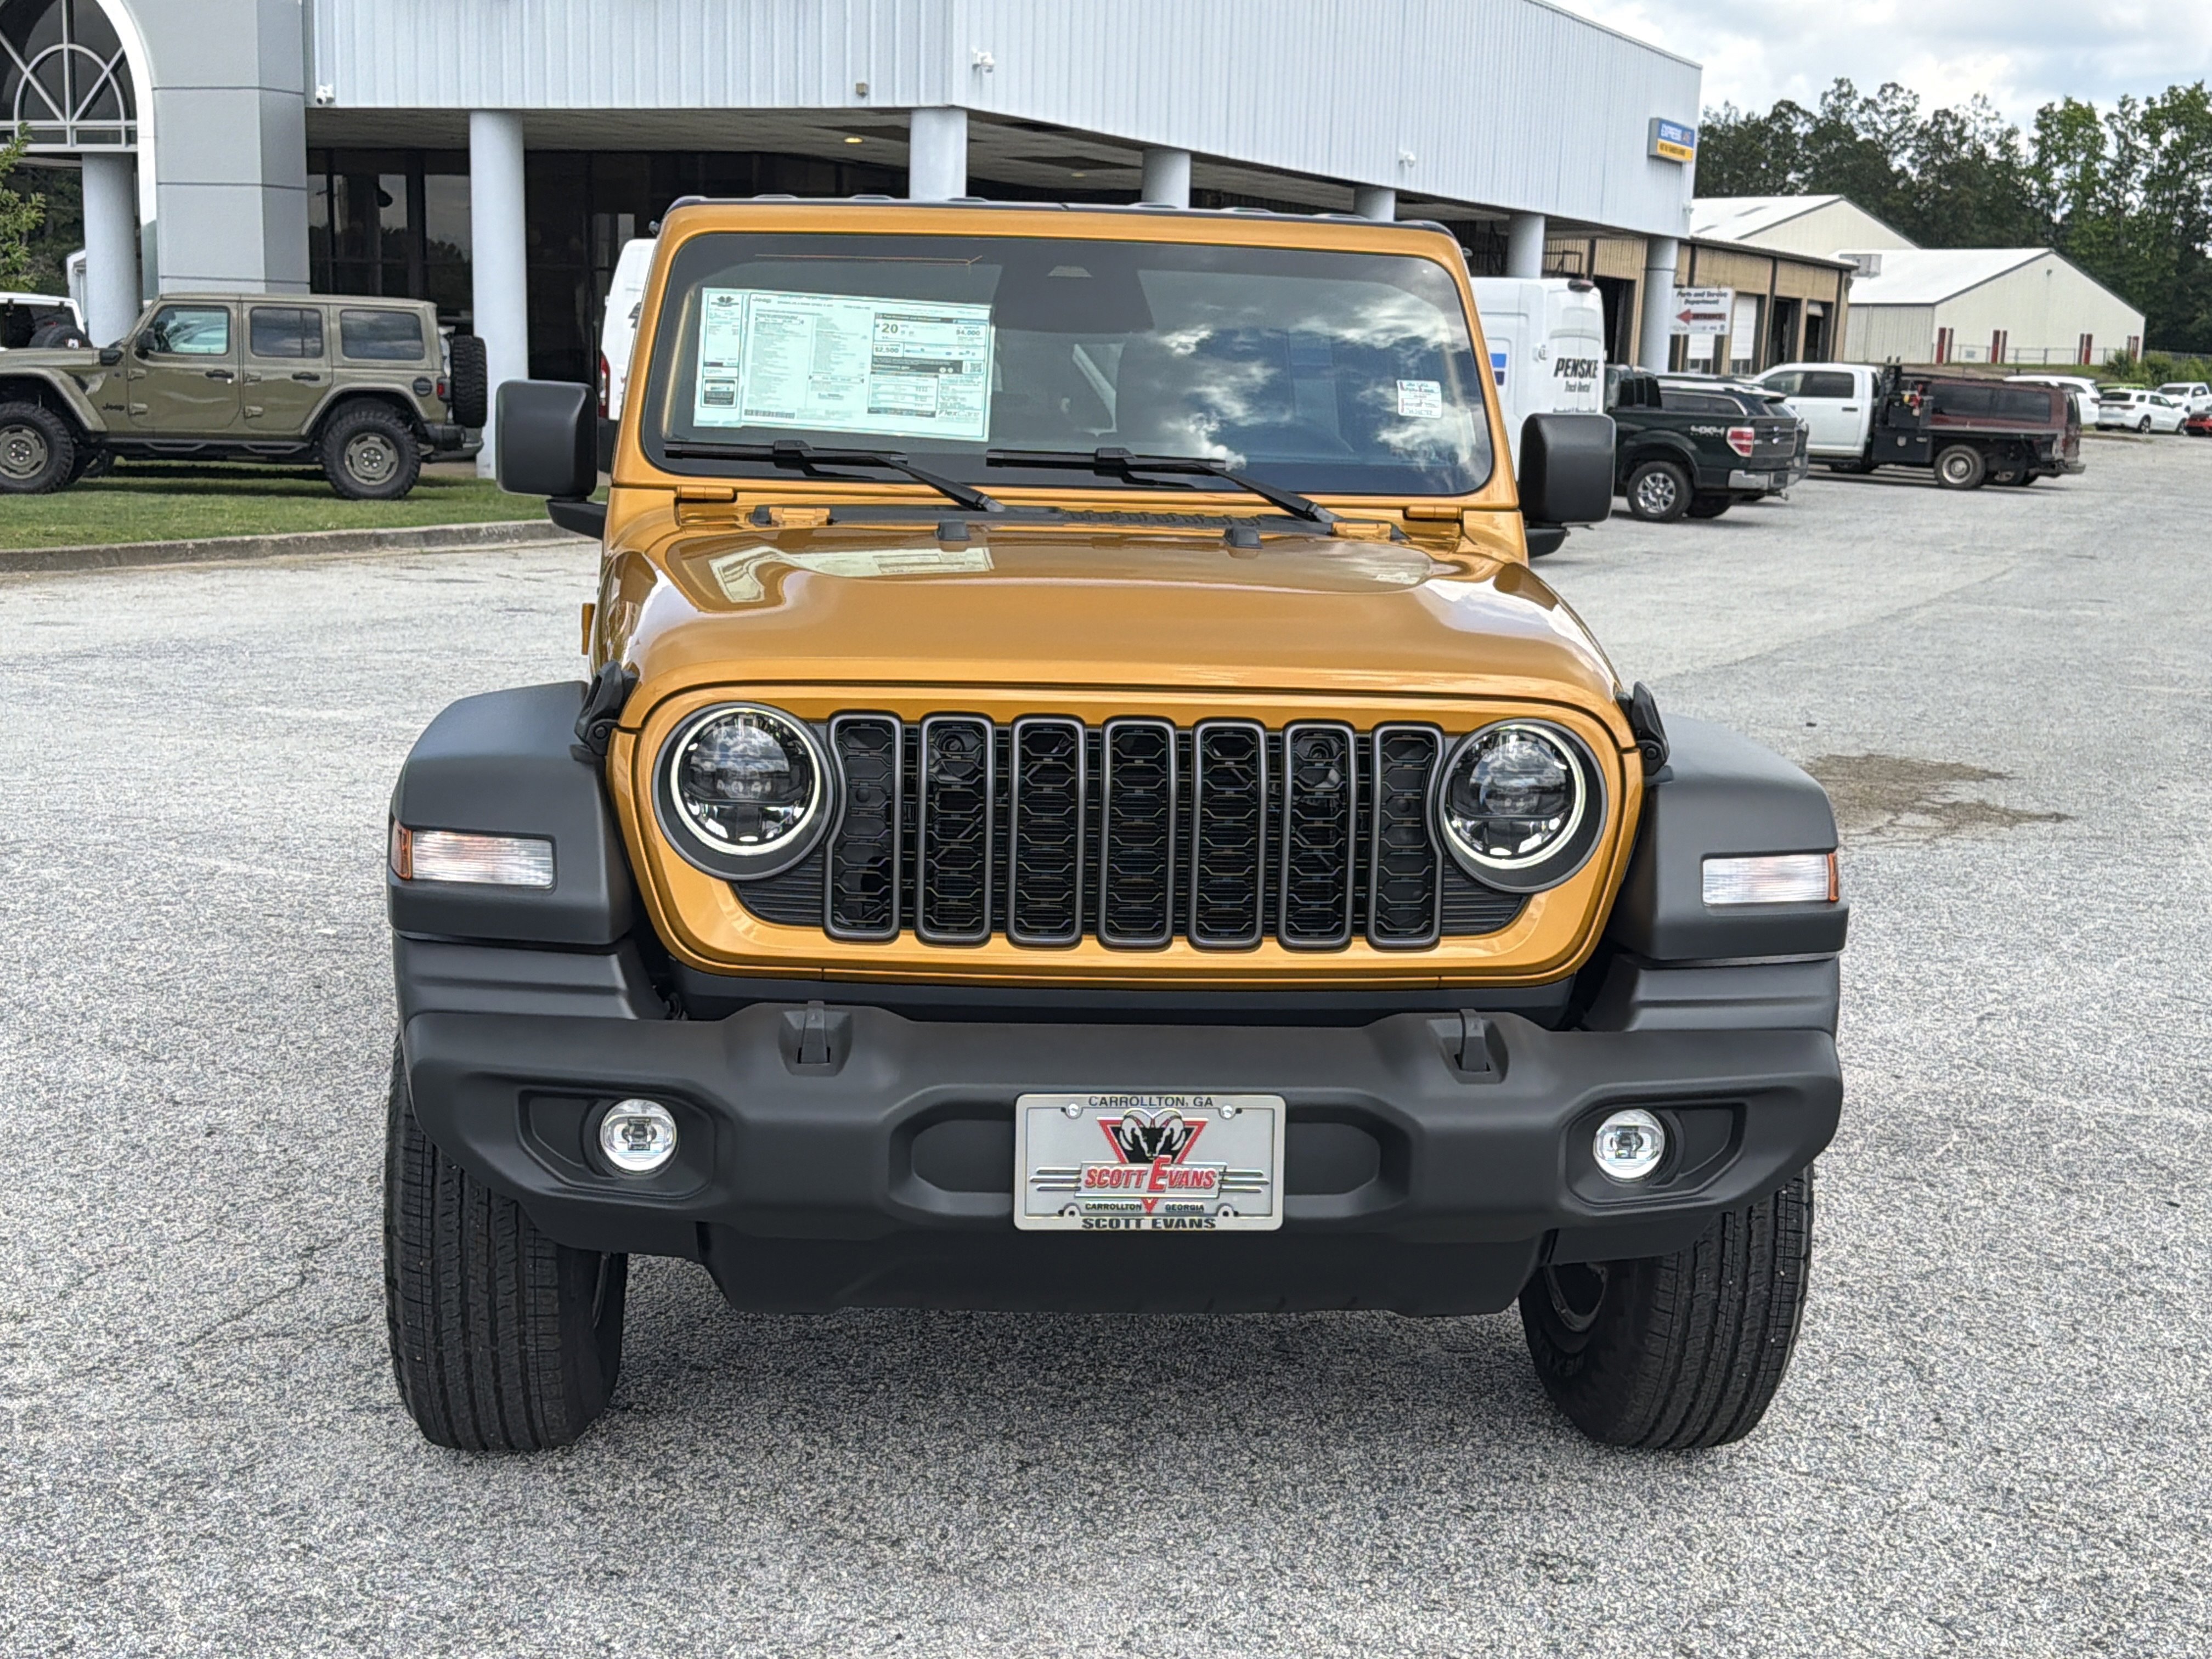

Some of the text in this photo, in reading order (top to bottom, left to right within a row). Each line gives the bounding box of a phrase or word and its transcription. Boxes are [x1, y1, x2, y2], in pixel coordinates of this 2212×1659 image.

[881, 323, 899, 334] 20
[1553, 358, 1599, 379] PENSKE
[1088, 1096, 1214, 1108] CARROLLTON, GA
[1085, 1168, 1148, 1188] SCOTT
[1165, 1204, 1205, 1212] GEORGIA
[1081, 1217, 1216, 1229] SCOTT EVANS
